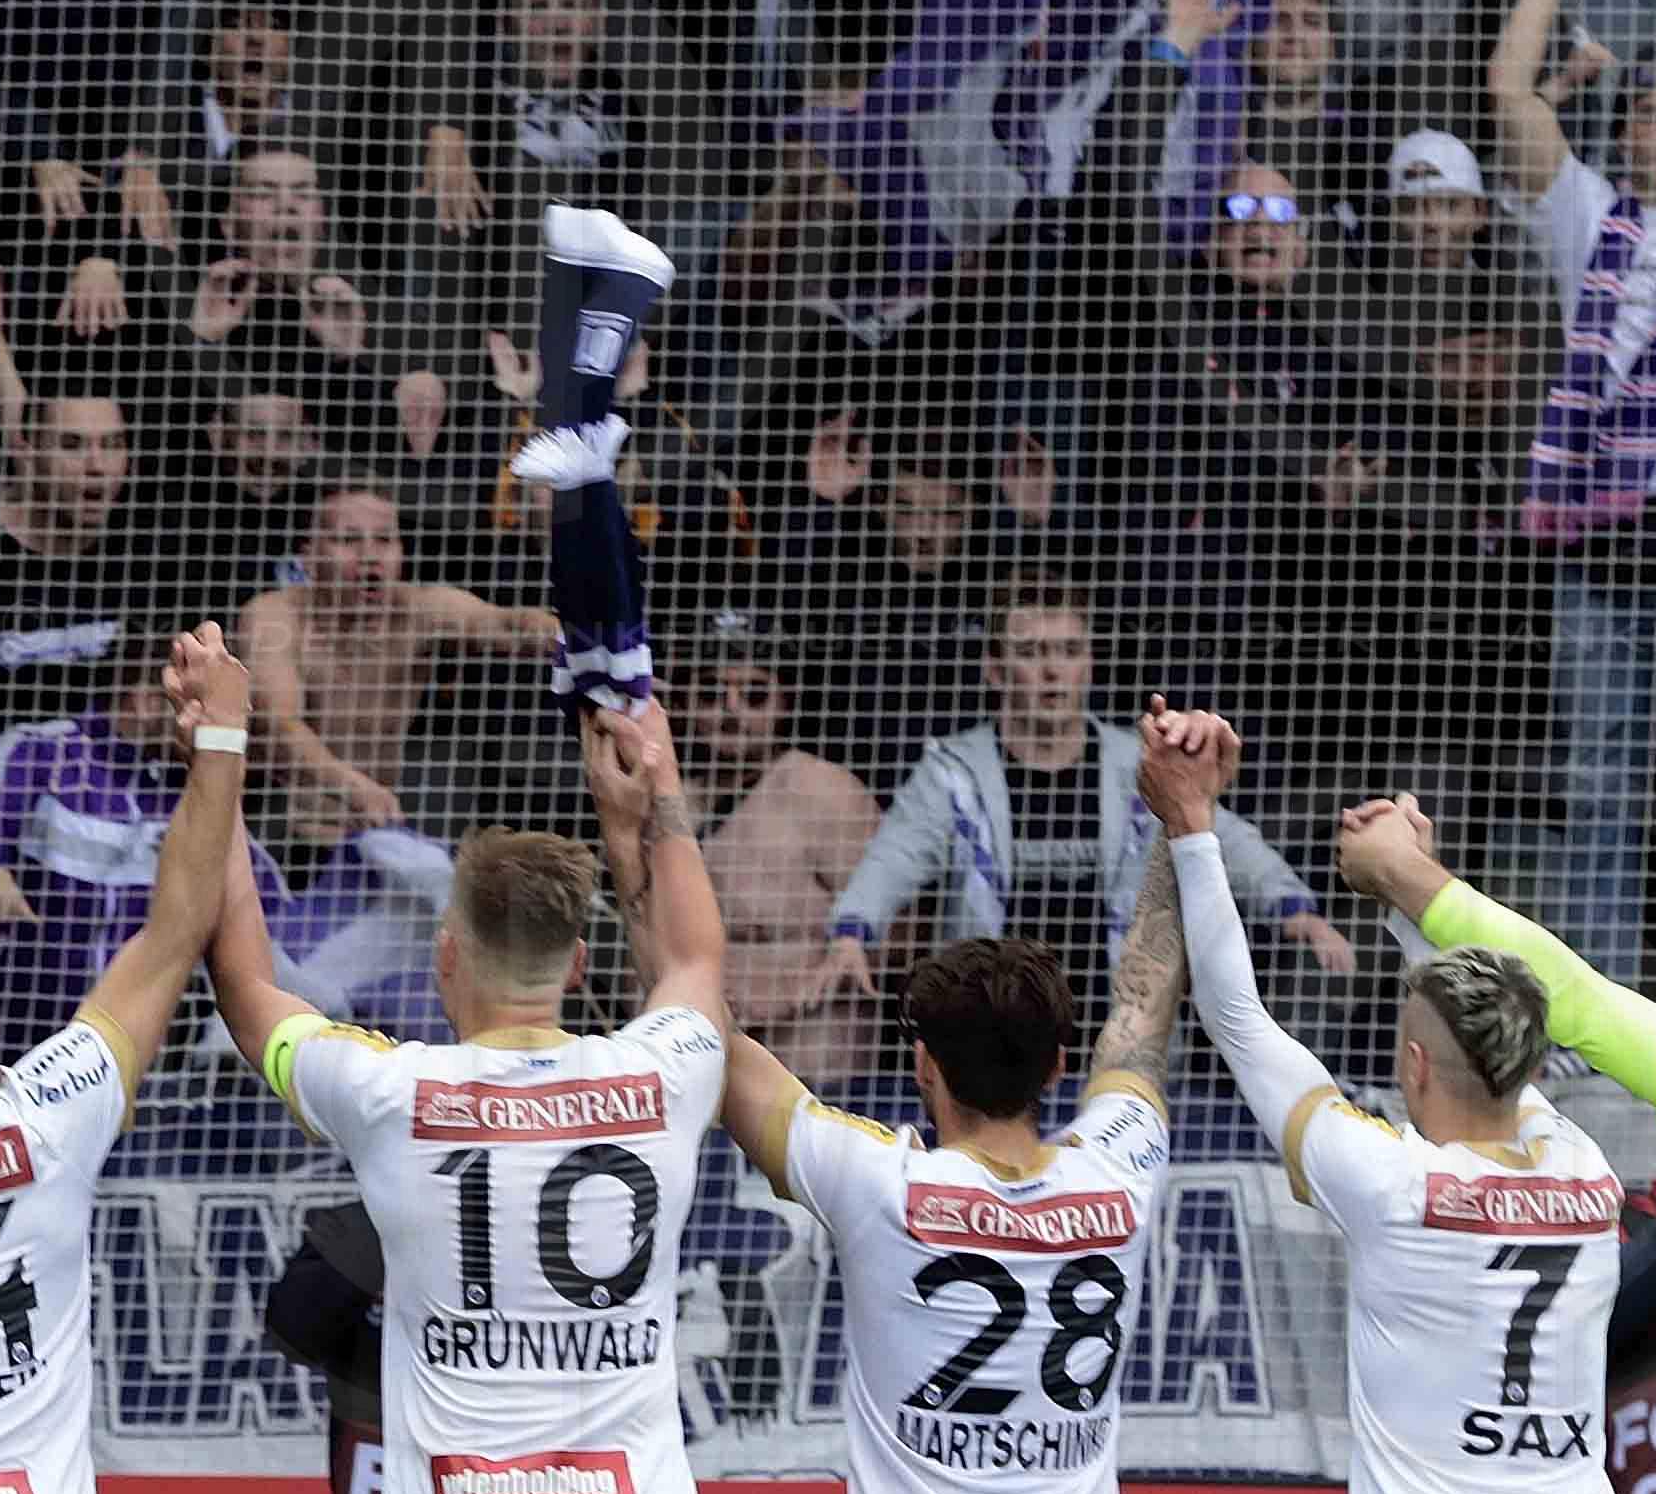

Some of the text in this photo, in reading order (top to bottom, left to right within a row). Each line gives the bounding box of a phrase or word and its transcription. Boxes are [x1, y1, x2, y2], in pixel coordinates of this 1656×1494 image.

[480, 1085, 663, 1133] GENERALI
[431, 1142, 660, 1311] 10
[969, 1198, 1131, 1245] GENERALI
[421, 1311, 662, 1371] GRÜNWALD
[901, 1251, 1128, 1414] 28
[1485, 1242, 1583, 1407] 7
[1461, 1408, 1594, 1459] SAX
